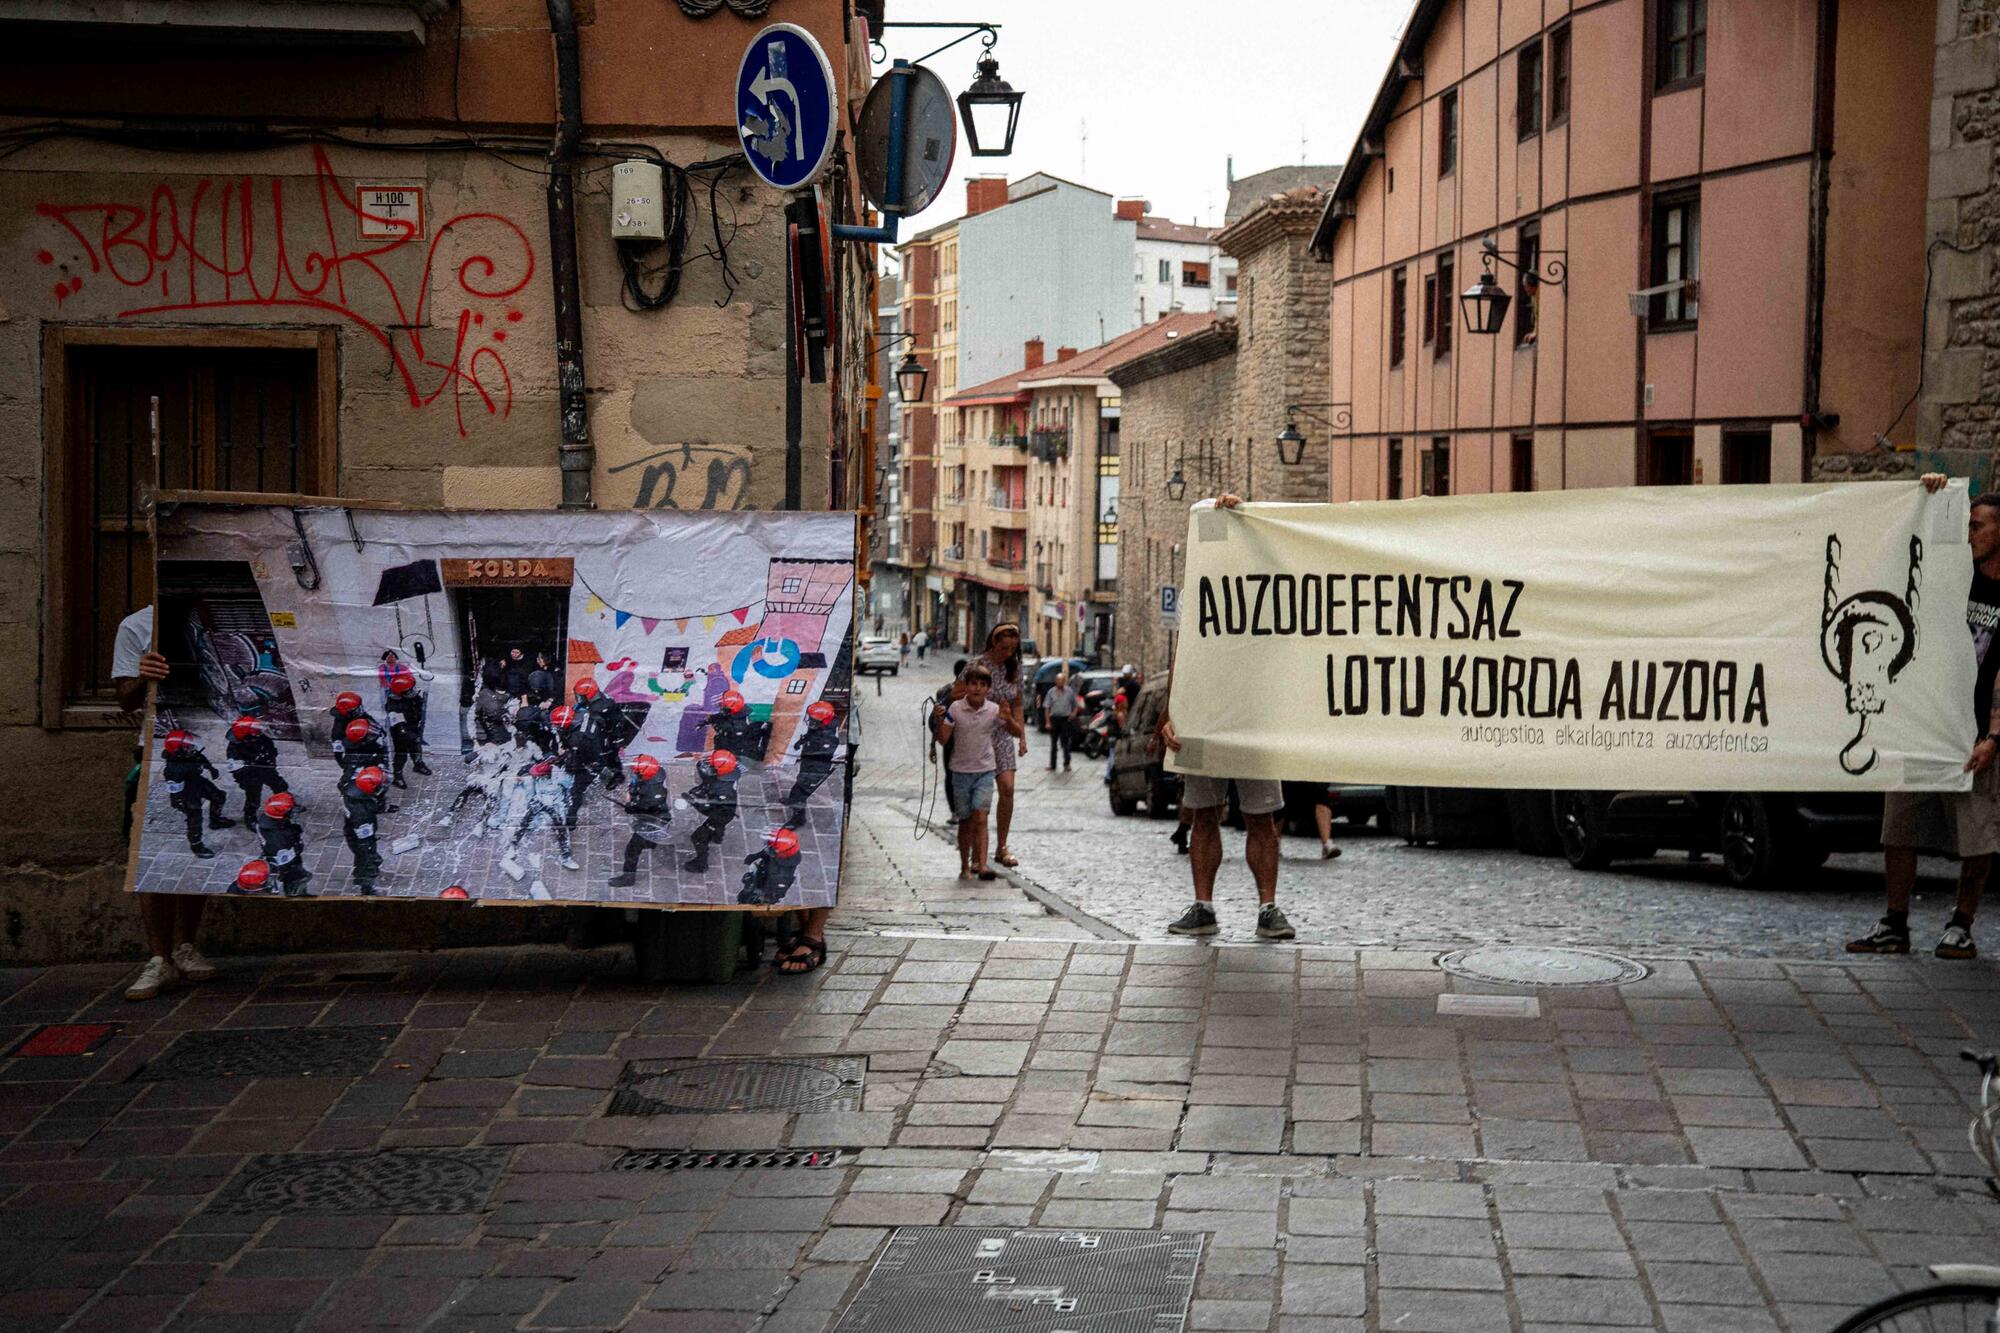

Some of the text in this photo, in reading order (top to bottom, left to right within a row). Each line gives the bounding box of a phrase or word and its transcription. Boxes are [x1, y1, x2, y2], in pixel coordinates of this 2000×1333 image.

[619, 167, 634, 175] 169
[375, 192, 404, 204] H 100
[466, 559, 549, 578] KORDA
[1198, 573, 1525, 641] AUZODEFENTSAZ
[1326, 653, 1769, 727] LOTU KORDA AUZORA
[1460, 725, 1770, 752] autogestioa elkarlaguntza auzodefentsa
